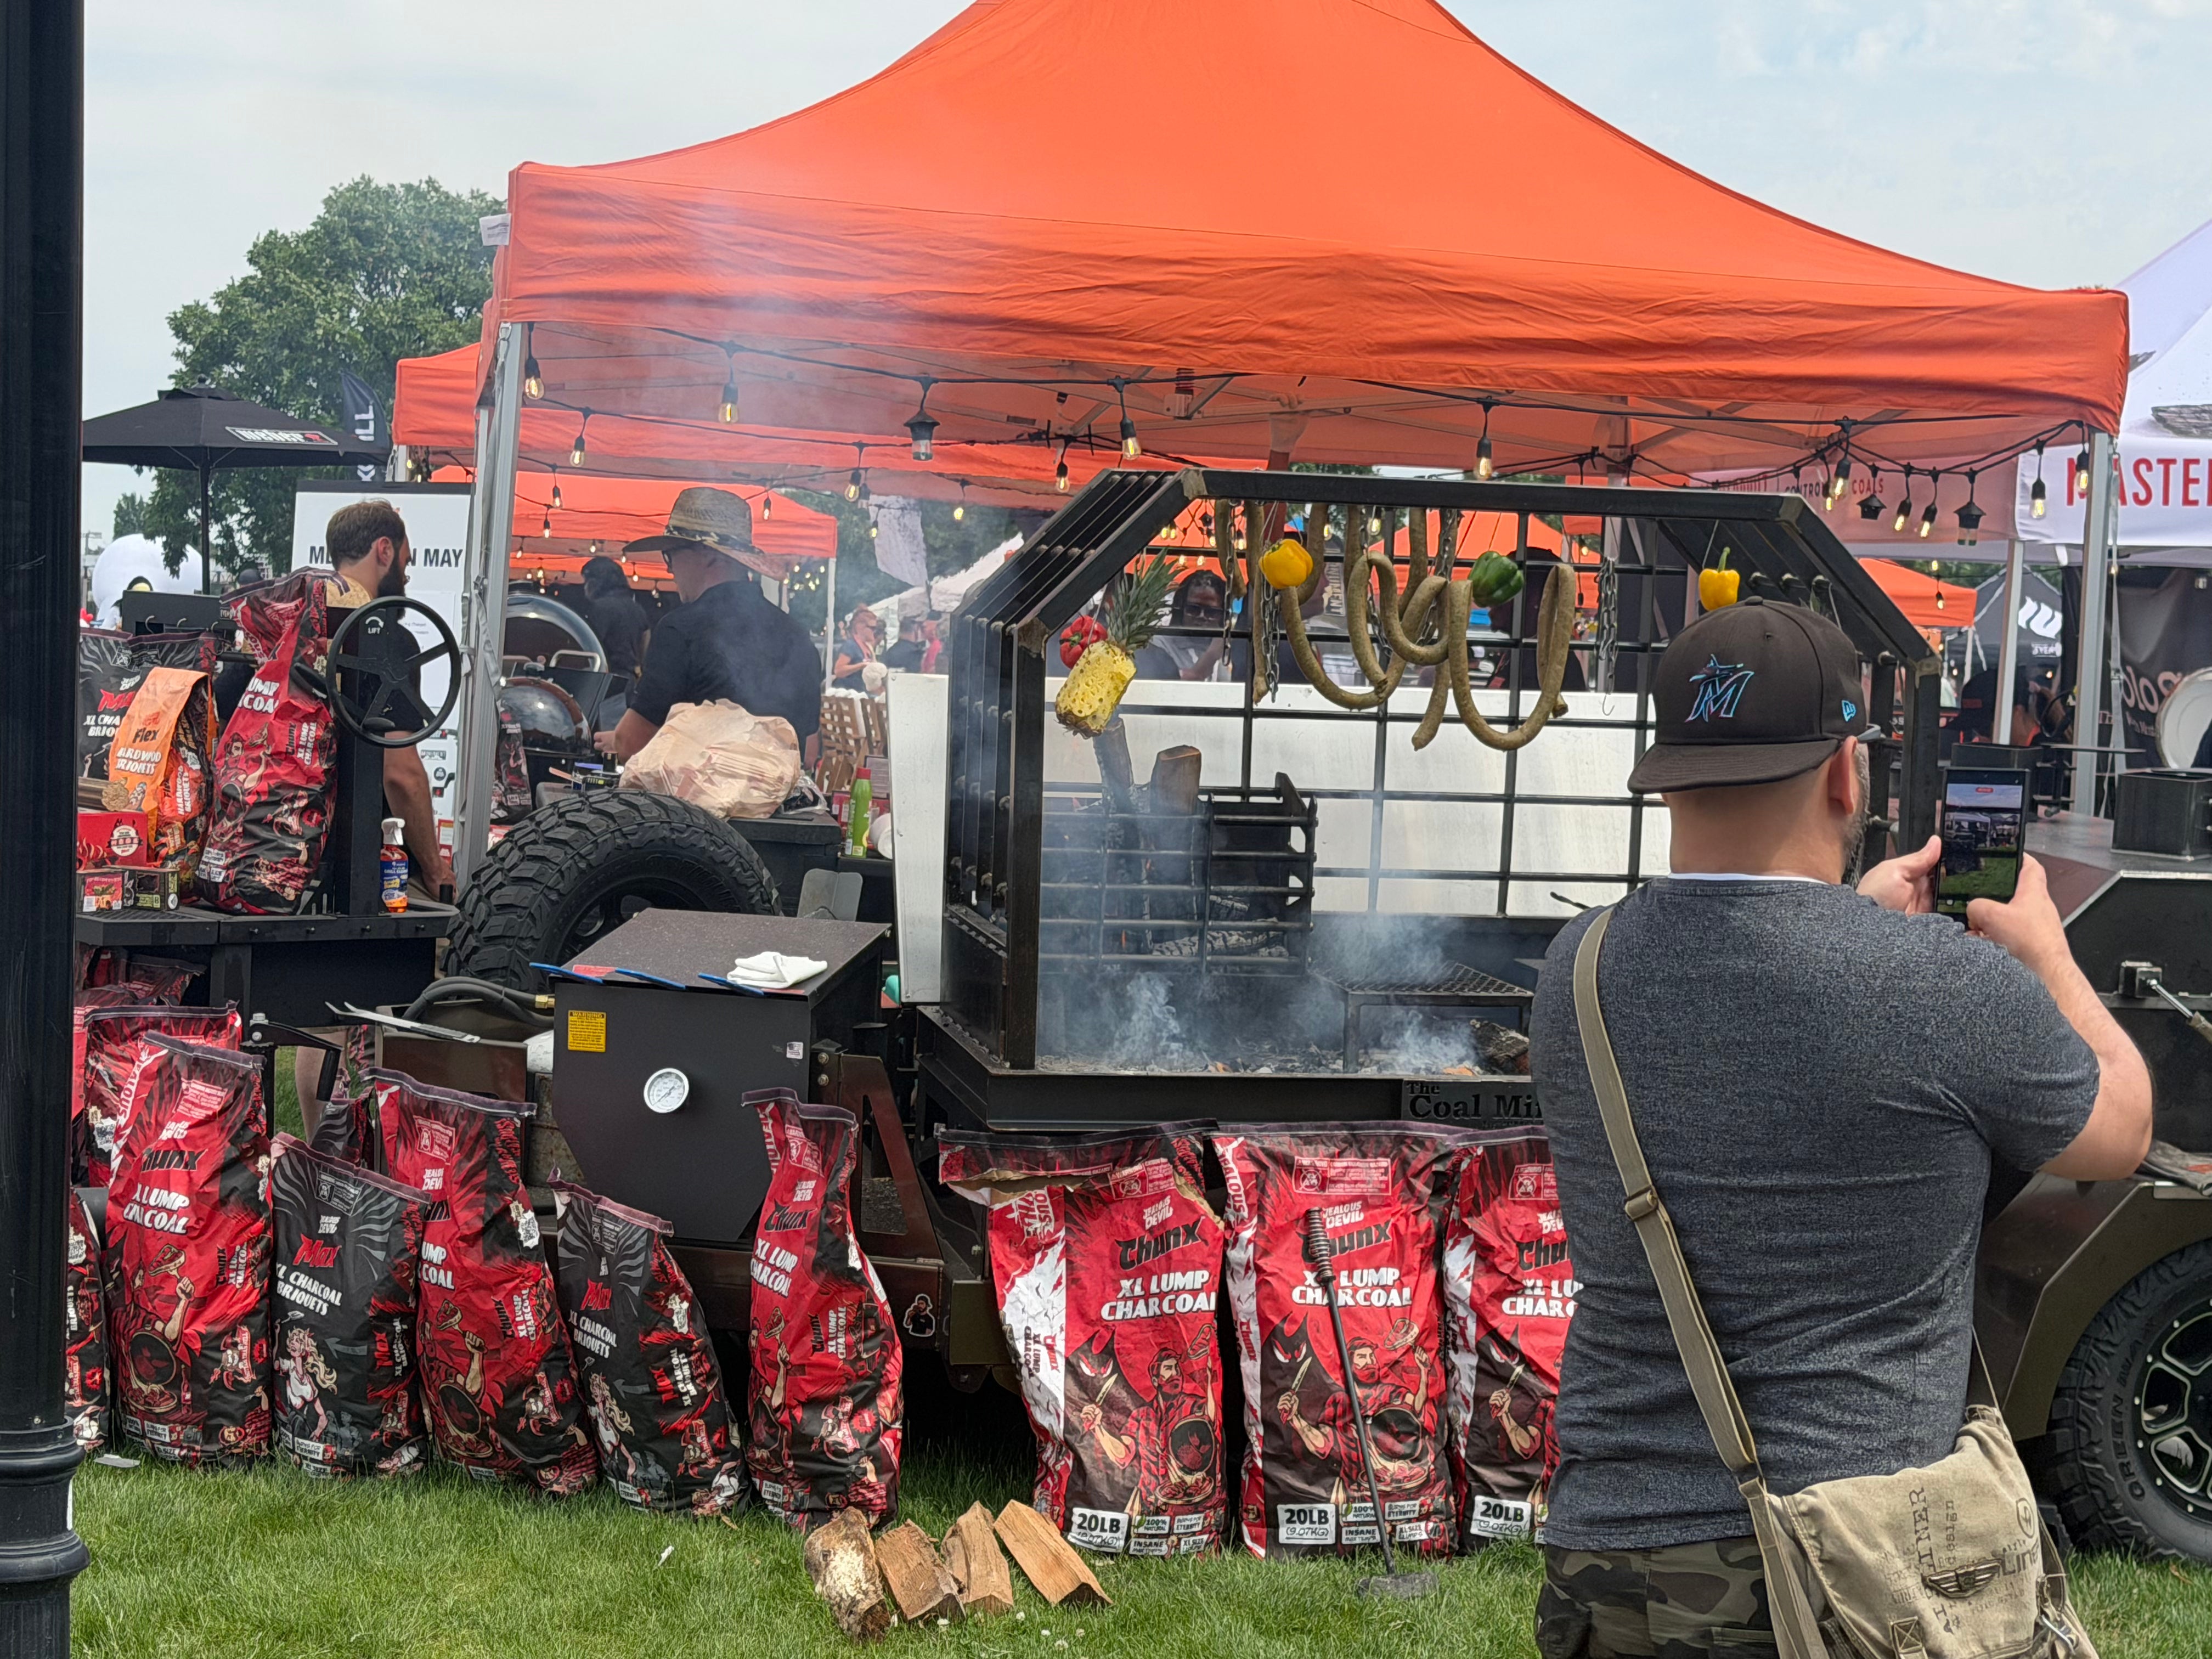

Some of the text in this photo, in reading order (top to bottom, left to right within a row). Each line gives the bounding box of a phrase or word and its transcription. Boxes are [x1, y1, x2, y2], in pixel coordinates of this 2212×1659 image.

[2066, 458, 2212, 506] MASTE
[423, 548, 463, 568] MAY
[247, 679, 280, 696] UMP
[132, 727, 161, 744] Flex
[1406, 1081, 1440, 1095] The
[1409, 1093, 1482, 1119] Coal
[1145, 1206, 1174, 1231] DEVIL
[1323, 1200, 1363, 1218] JEALOUS
[1325, 1210, 1364, 1229] DEVIL
[292, 1233, 342, 1268] Max
[421, 1241, 447, 1265] UMP
[754, 1238, 799, 1274] XL LUMP
[289, 1271, 342, 1306] CHARCOAL
[1116, 1269, 1210, 1299] XL LUMP
[1339, 1267, 1401, 1288] LUMP
[579, 1316, 618, 1348] CHARCOAL
[827, 1310, 837, 1355] XL LUMP
[1077, 1512, 1121, 1533] 20LB
[1284, 1508, 1330, 1525] 20LB
[1480, 1500, 1525, 1522] 20LB
